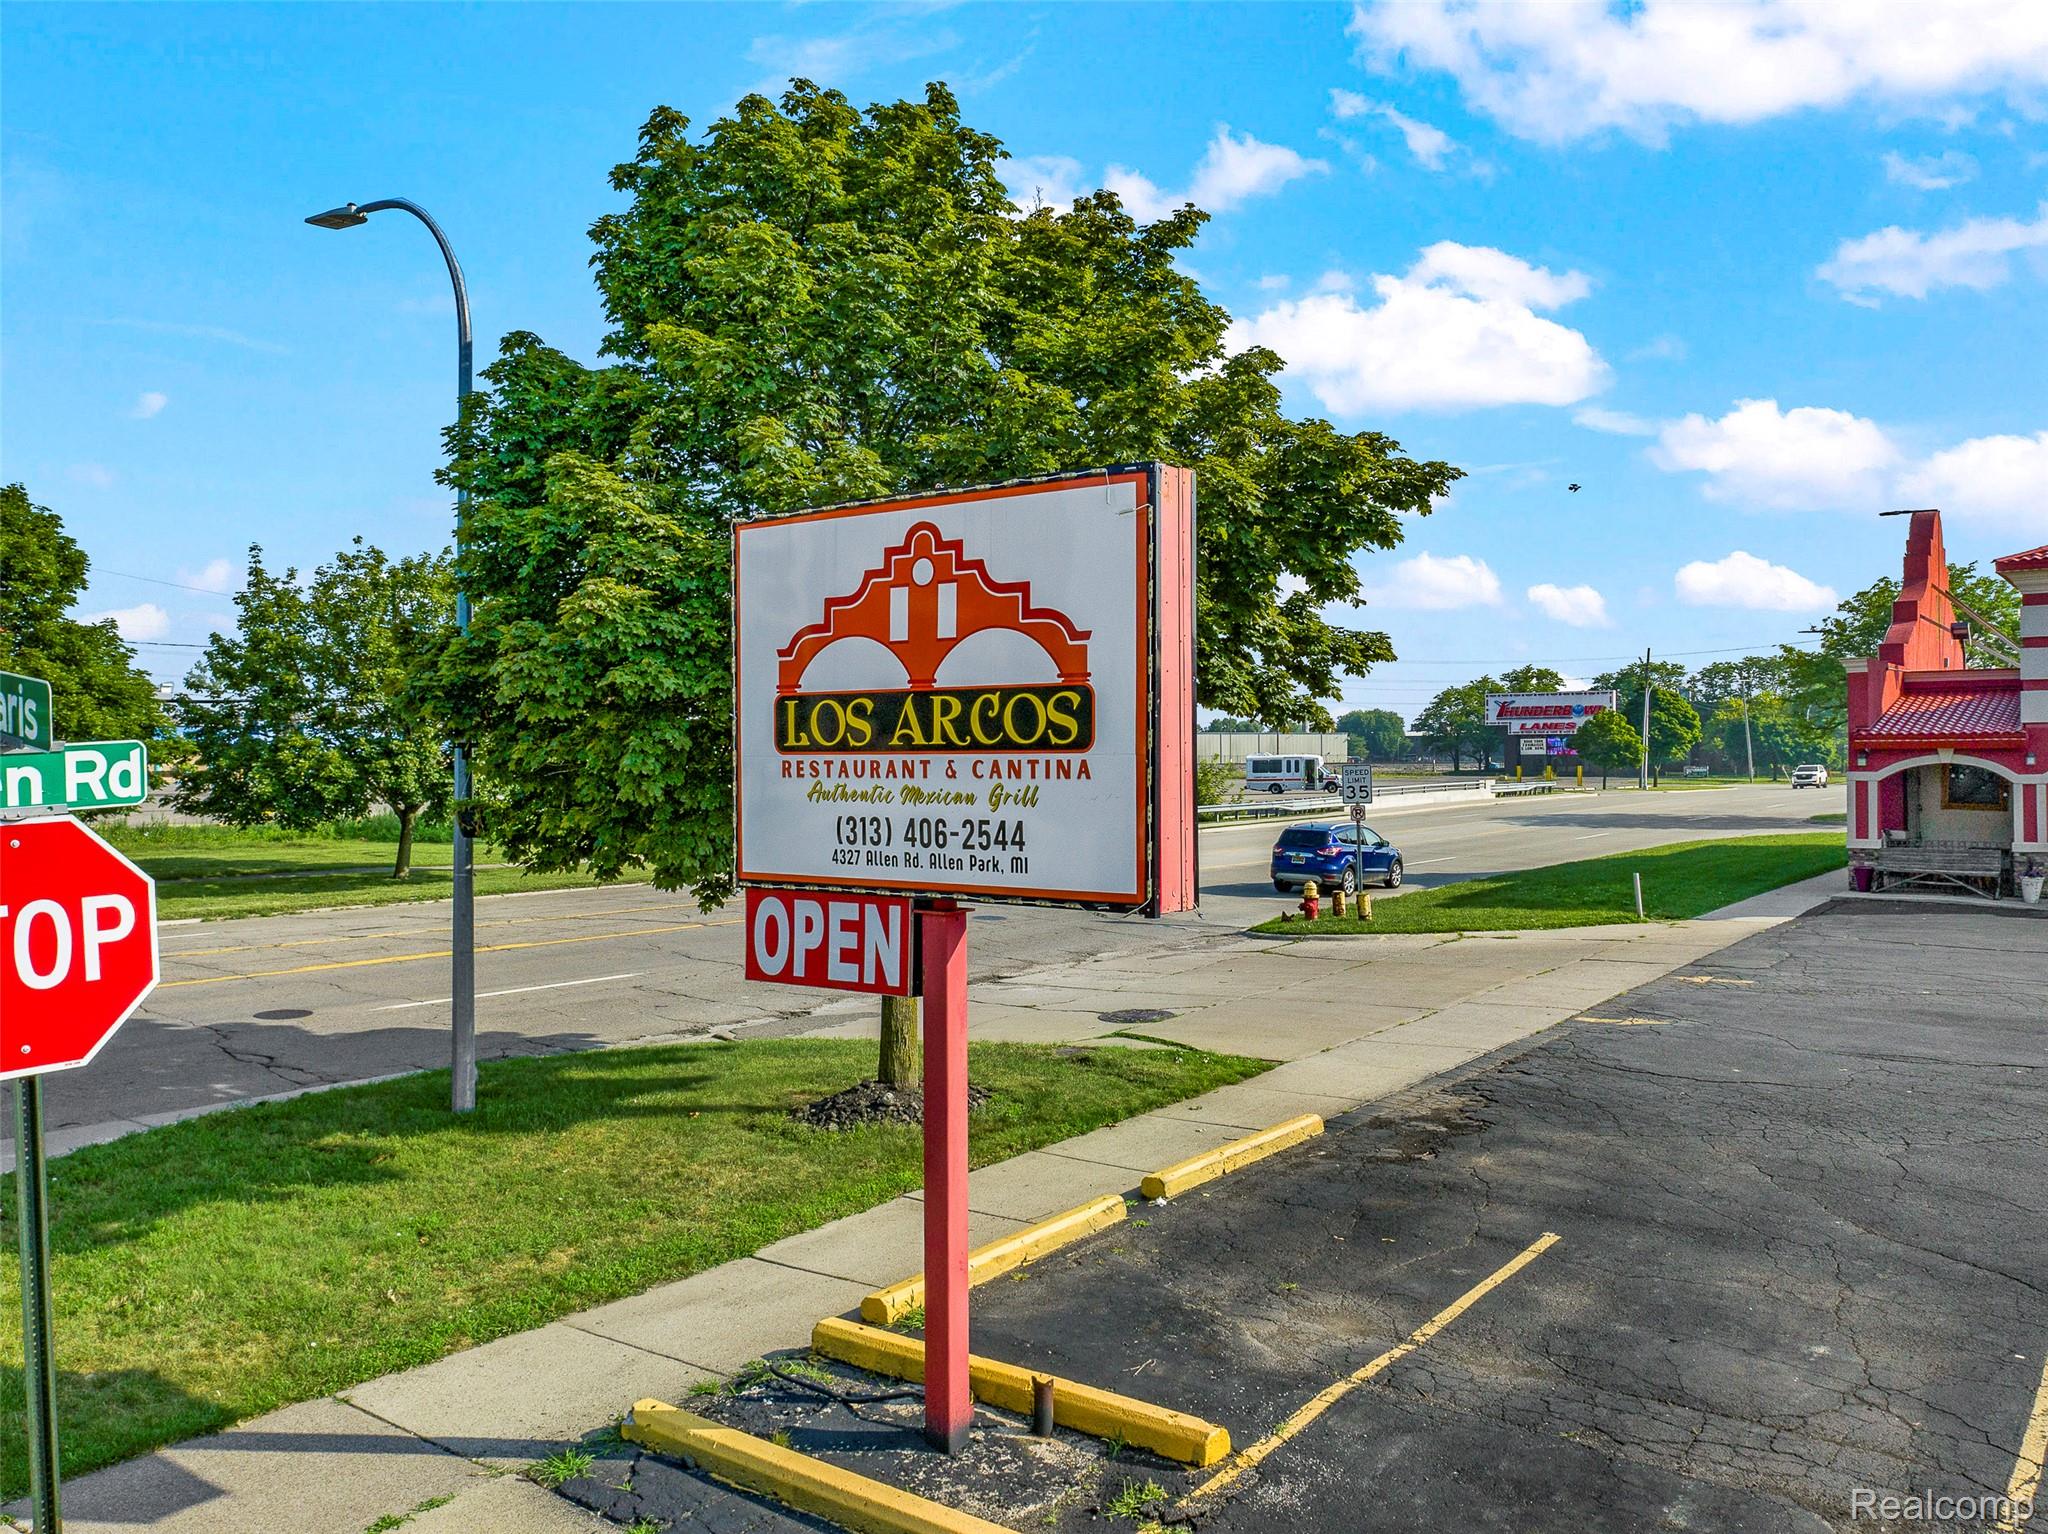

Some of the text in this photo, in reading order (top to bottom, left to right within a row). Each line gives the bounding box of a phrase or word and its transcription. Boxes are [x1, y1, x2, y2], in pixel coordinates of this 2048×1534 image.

[783, 691, 1081, 747] LOS ARCOS
[1520, 722, 1577, 730] LANES
[0, 747, 142, 807] n Rd
[781, 759, 1092, 780] RESTAURANT & CANTINA
[807, 779, 1040, 812] Authentic Mexican Grill
[1346, 785, 1369, 799] 35
[835, 815, 1026, 852] (313) 406-2544
[832, 848, 1029, 875] 4327 Allen Rd. Allen Park, MI
[0, 892, 137, 991] OP
[753, 895, 902, 988] OPEN
